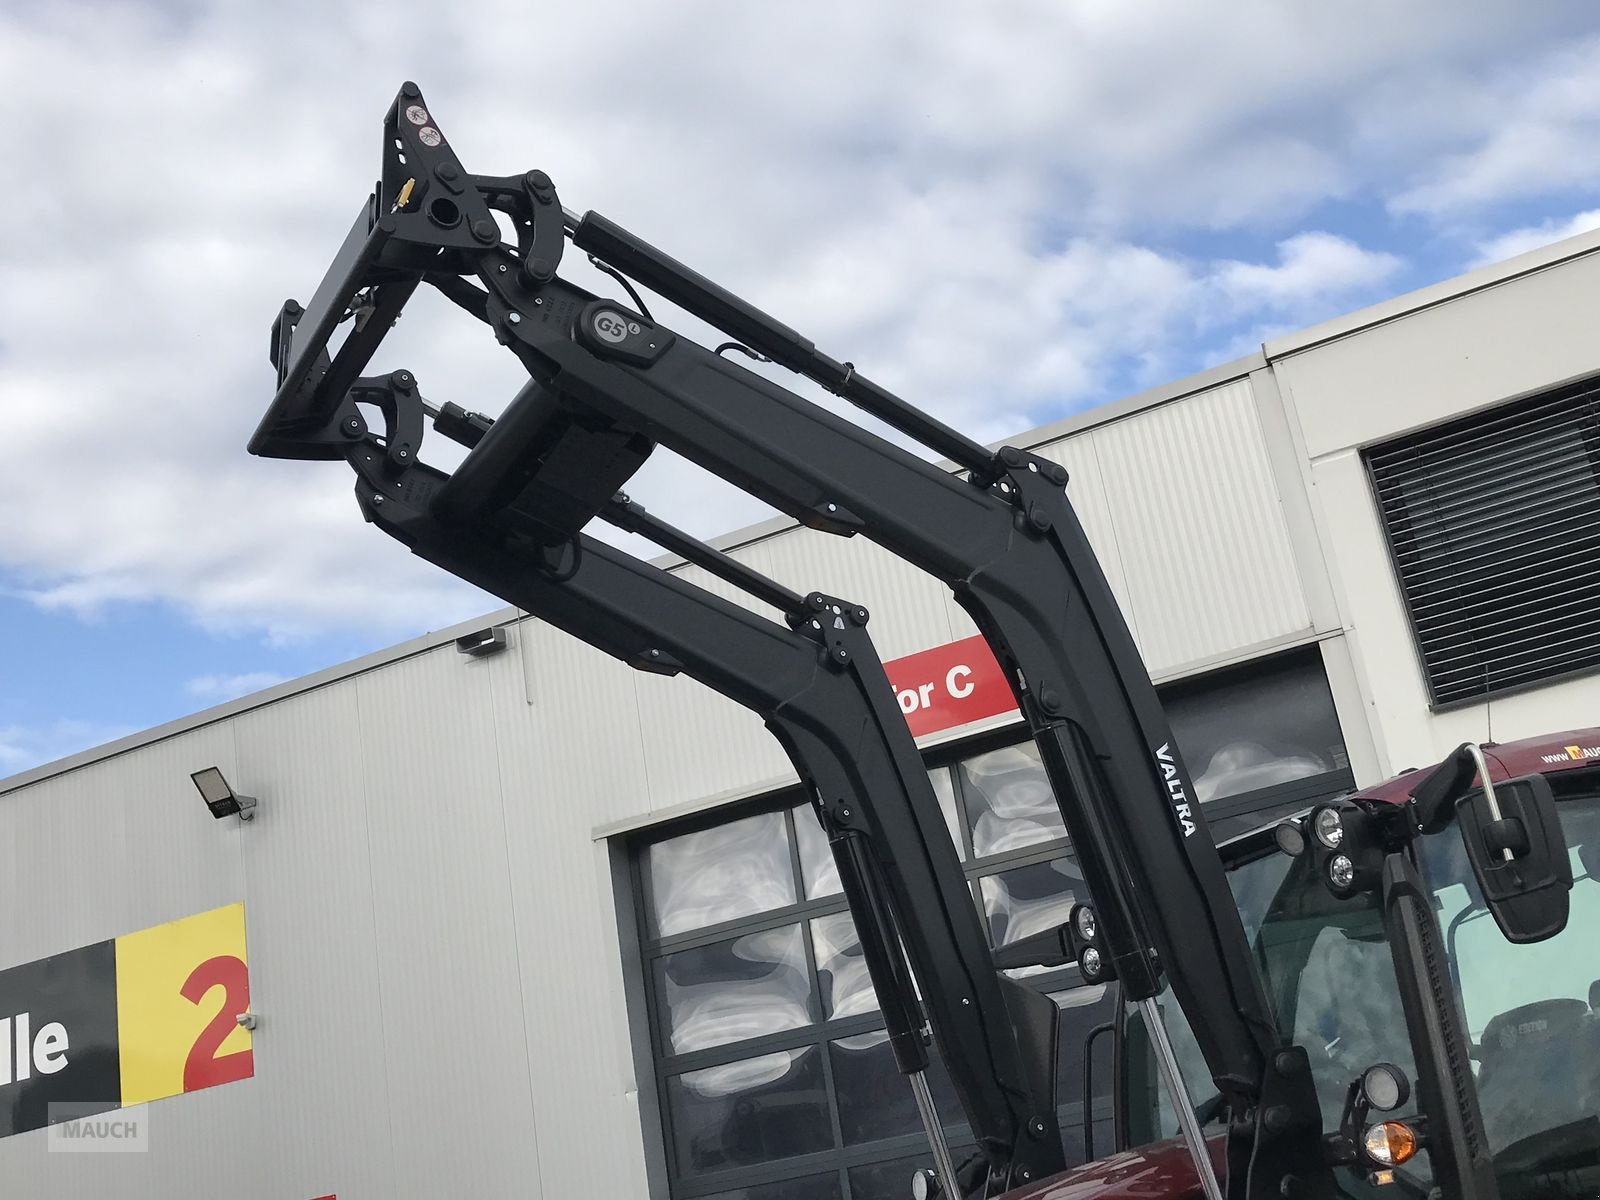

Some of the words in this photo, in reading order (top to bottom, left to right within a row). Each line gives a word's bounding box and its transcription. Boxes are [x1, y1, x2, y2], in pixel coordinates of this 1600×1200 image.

[597, 317, 625, 337] G5
[891, 681, 935, 714] or
[945, 664, 975, 699] C
[1155, 742, 1196, 837] VALTRA
[179, 955, 255, 1093] 2
